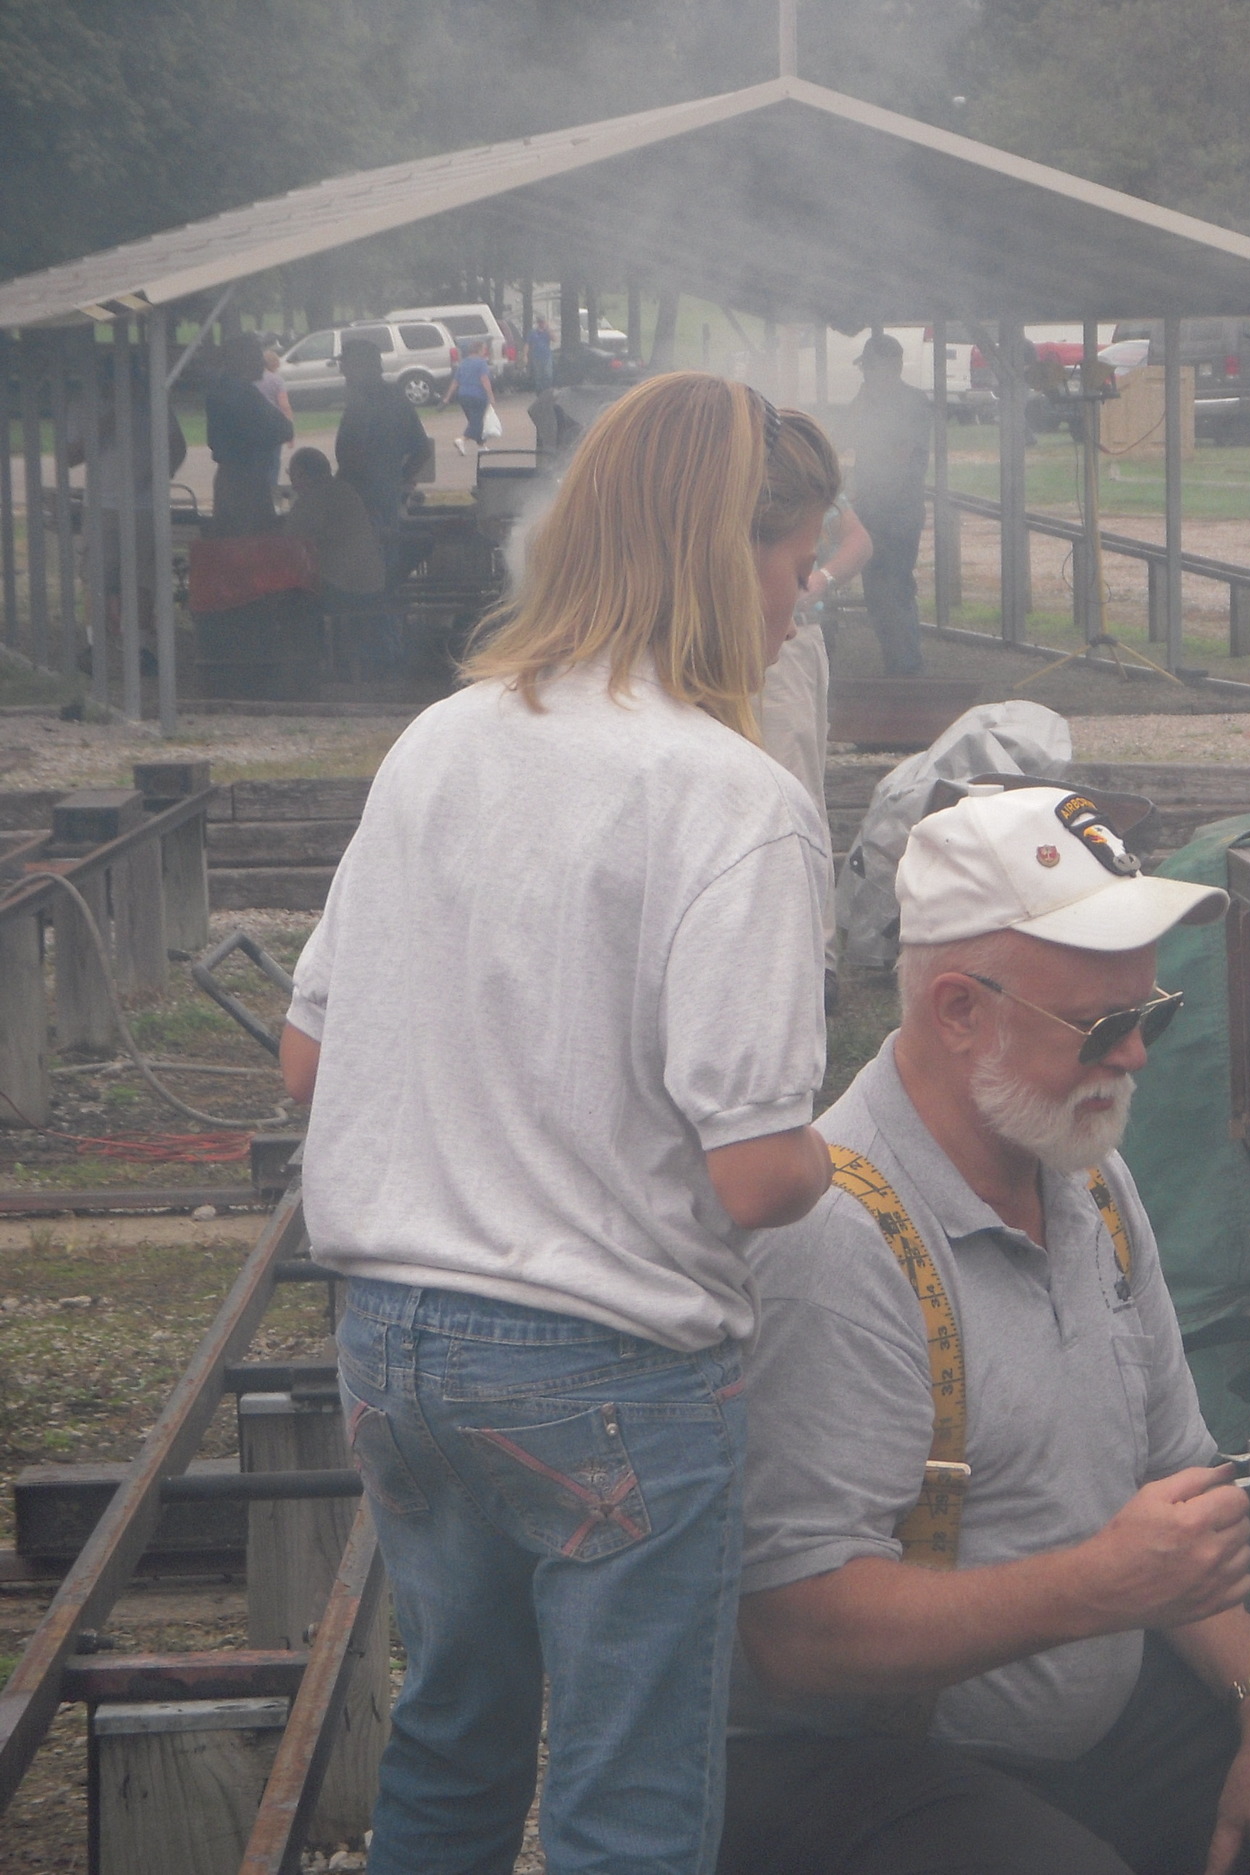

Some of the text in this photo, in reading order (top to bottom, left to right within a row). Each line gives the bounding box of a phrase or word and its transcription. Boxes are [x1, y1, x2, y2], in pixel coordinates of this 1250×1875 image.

[1060, 797, 1098, 820] AIRBO
[926, 1283, 941, 1309] 34
[937, 1324, 951, 1351] 33
[940, 1367, 954, 1396] 32
